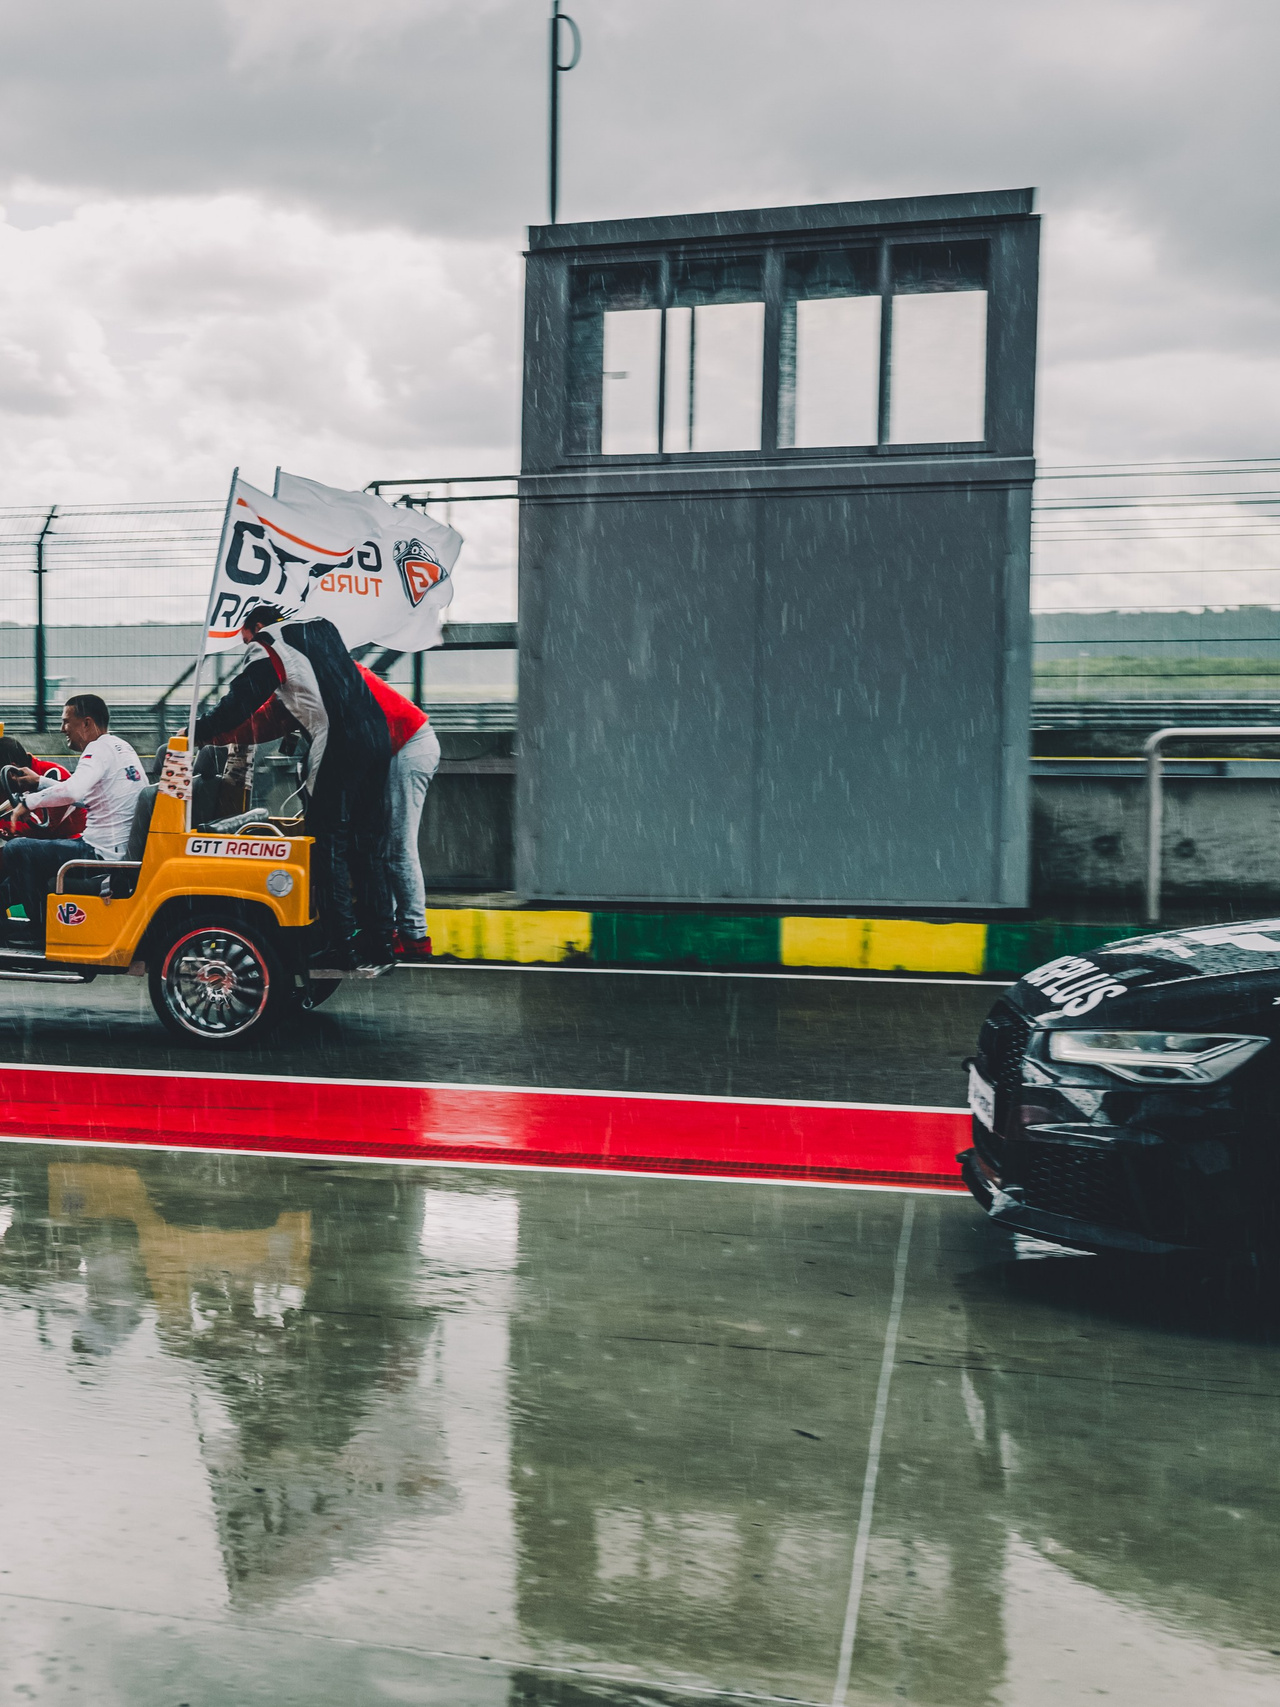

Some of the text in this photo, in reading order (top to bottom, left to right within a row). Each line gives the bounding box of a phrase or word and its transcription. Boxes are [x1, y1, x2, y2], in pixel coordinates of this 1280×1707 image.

[191, 840, 287, 858] GTT RACING
[58, 903, 77, 924] VP
